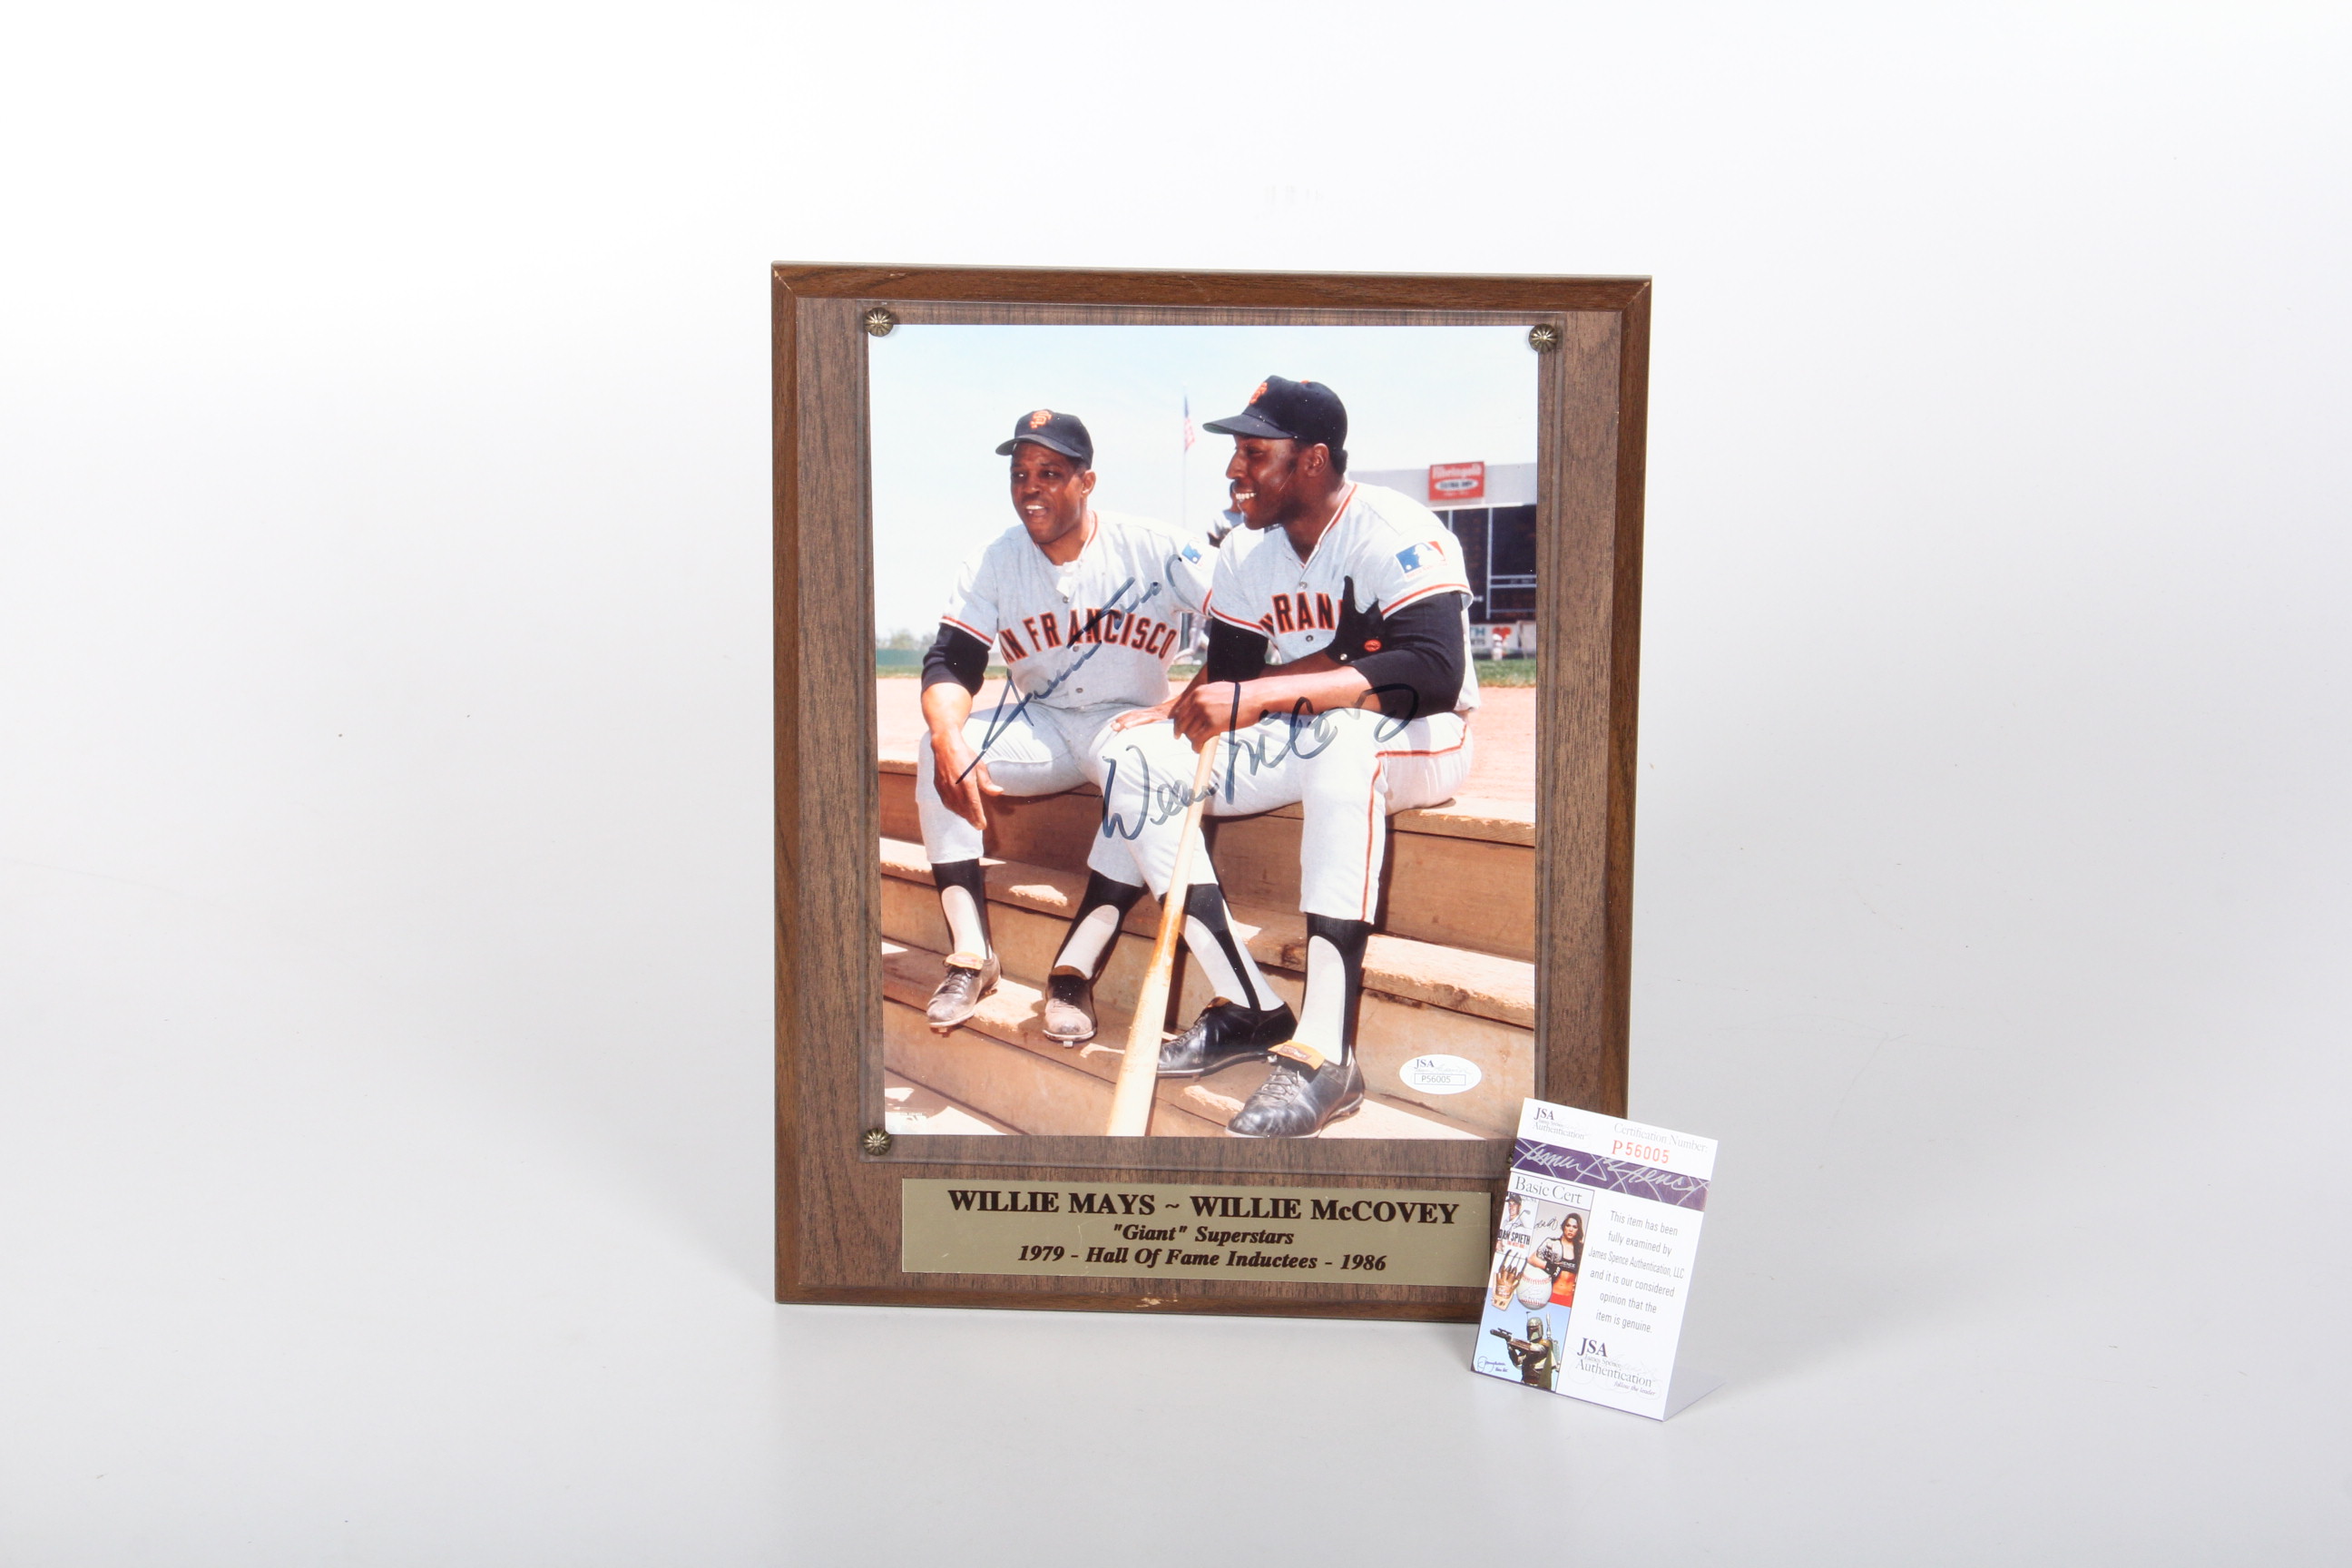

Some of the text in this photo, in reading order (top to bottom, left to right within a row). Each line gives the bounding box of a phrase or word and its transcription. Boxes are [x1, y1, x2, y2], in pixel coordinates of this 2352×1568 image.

[1415, 1058, 1435, 1070] JSA
[1421, 1074, 1452, 1084] P56005
[1534, 1107, 1554, 1121] JSA
[1534, 1122, 1584, 1140] Authentication
[1613, 1122, 1709, 1152] Certification Number:
[1514, 1176, 1548, 1197] Basic
[1552, 1185, 1583, 1205] Cert
[947, 1190, 1060, 1213] WILLIE
[1068, 1192, 1155, 1215] MAYS
[1190, 1195, 1301, 1220] WILLIE
[1310, 1199, 1460, 1224] McCOVEY
[1114, 1223, 1294, 1246] "Giant" Superstars
[1610, 1210, 1678, 1236] This item has been
[1607, 1230, 1672, 1258] fully examined by
[1017, 1245, 1065, 1261] 1979
[1085, 1246, 1129, 1264] Hall
[1134, 1248, 1162, 1269] Of
[1165, 1249, 1220, 1267] Fame
[1225, 1250, 1318, 1269] Inductees
[1340, 1254, 1387, 1271] 1986
[1588, 1247, 1607, 1260] James
[1607, 1251, 1629, 1266] Spence
[1672, 1267, 1685, 1279] LLC
[1590, 1269, 1675, 1298] and it is our considered
[1599, 1291, 1657, 1314] opinion that the
[1595, 1309, 1652, 1334] item is genuine.
[1576, 1337, 1608, 1357] JSA
[1575, 1358, 1651, 1387] Authentication
[1614, 1381, 1630, 1389] follow
[1640, 1387, 1656, 1396] leader
